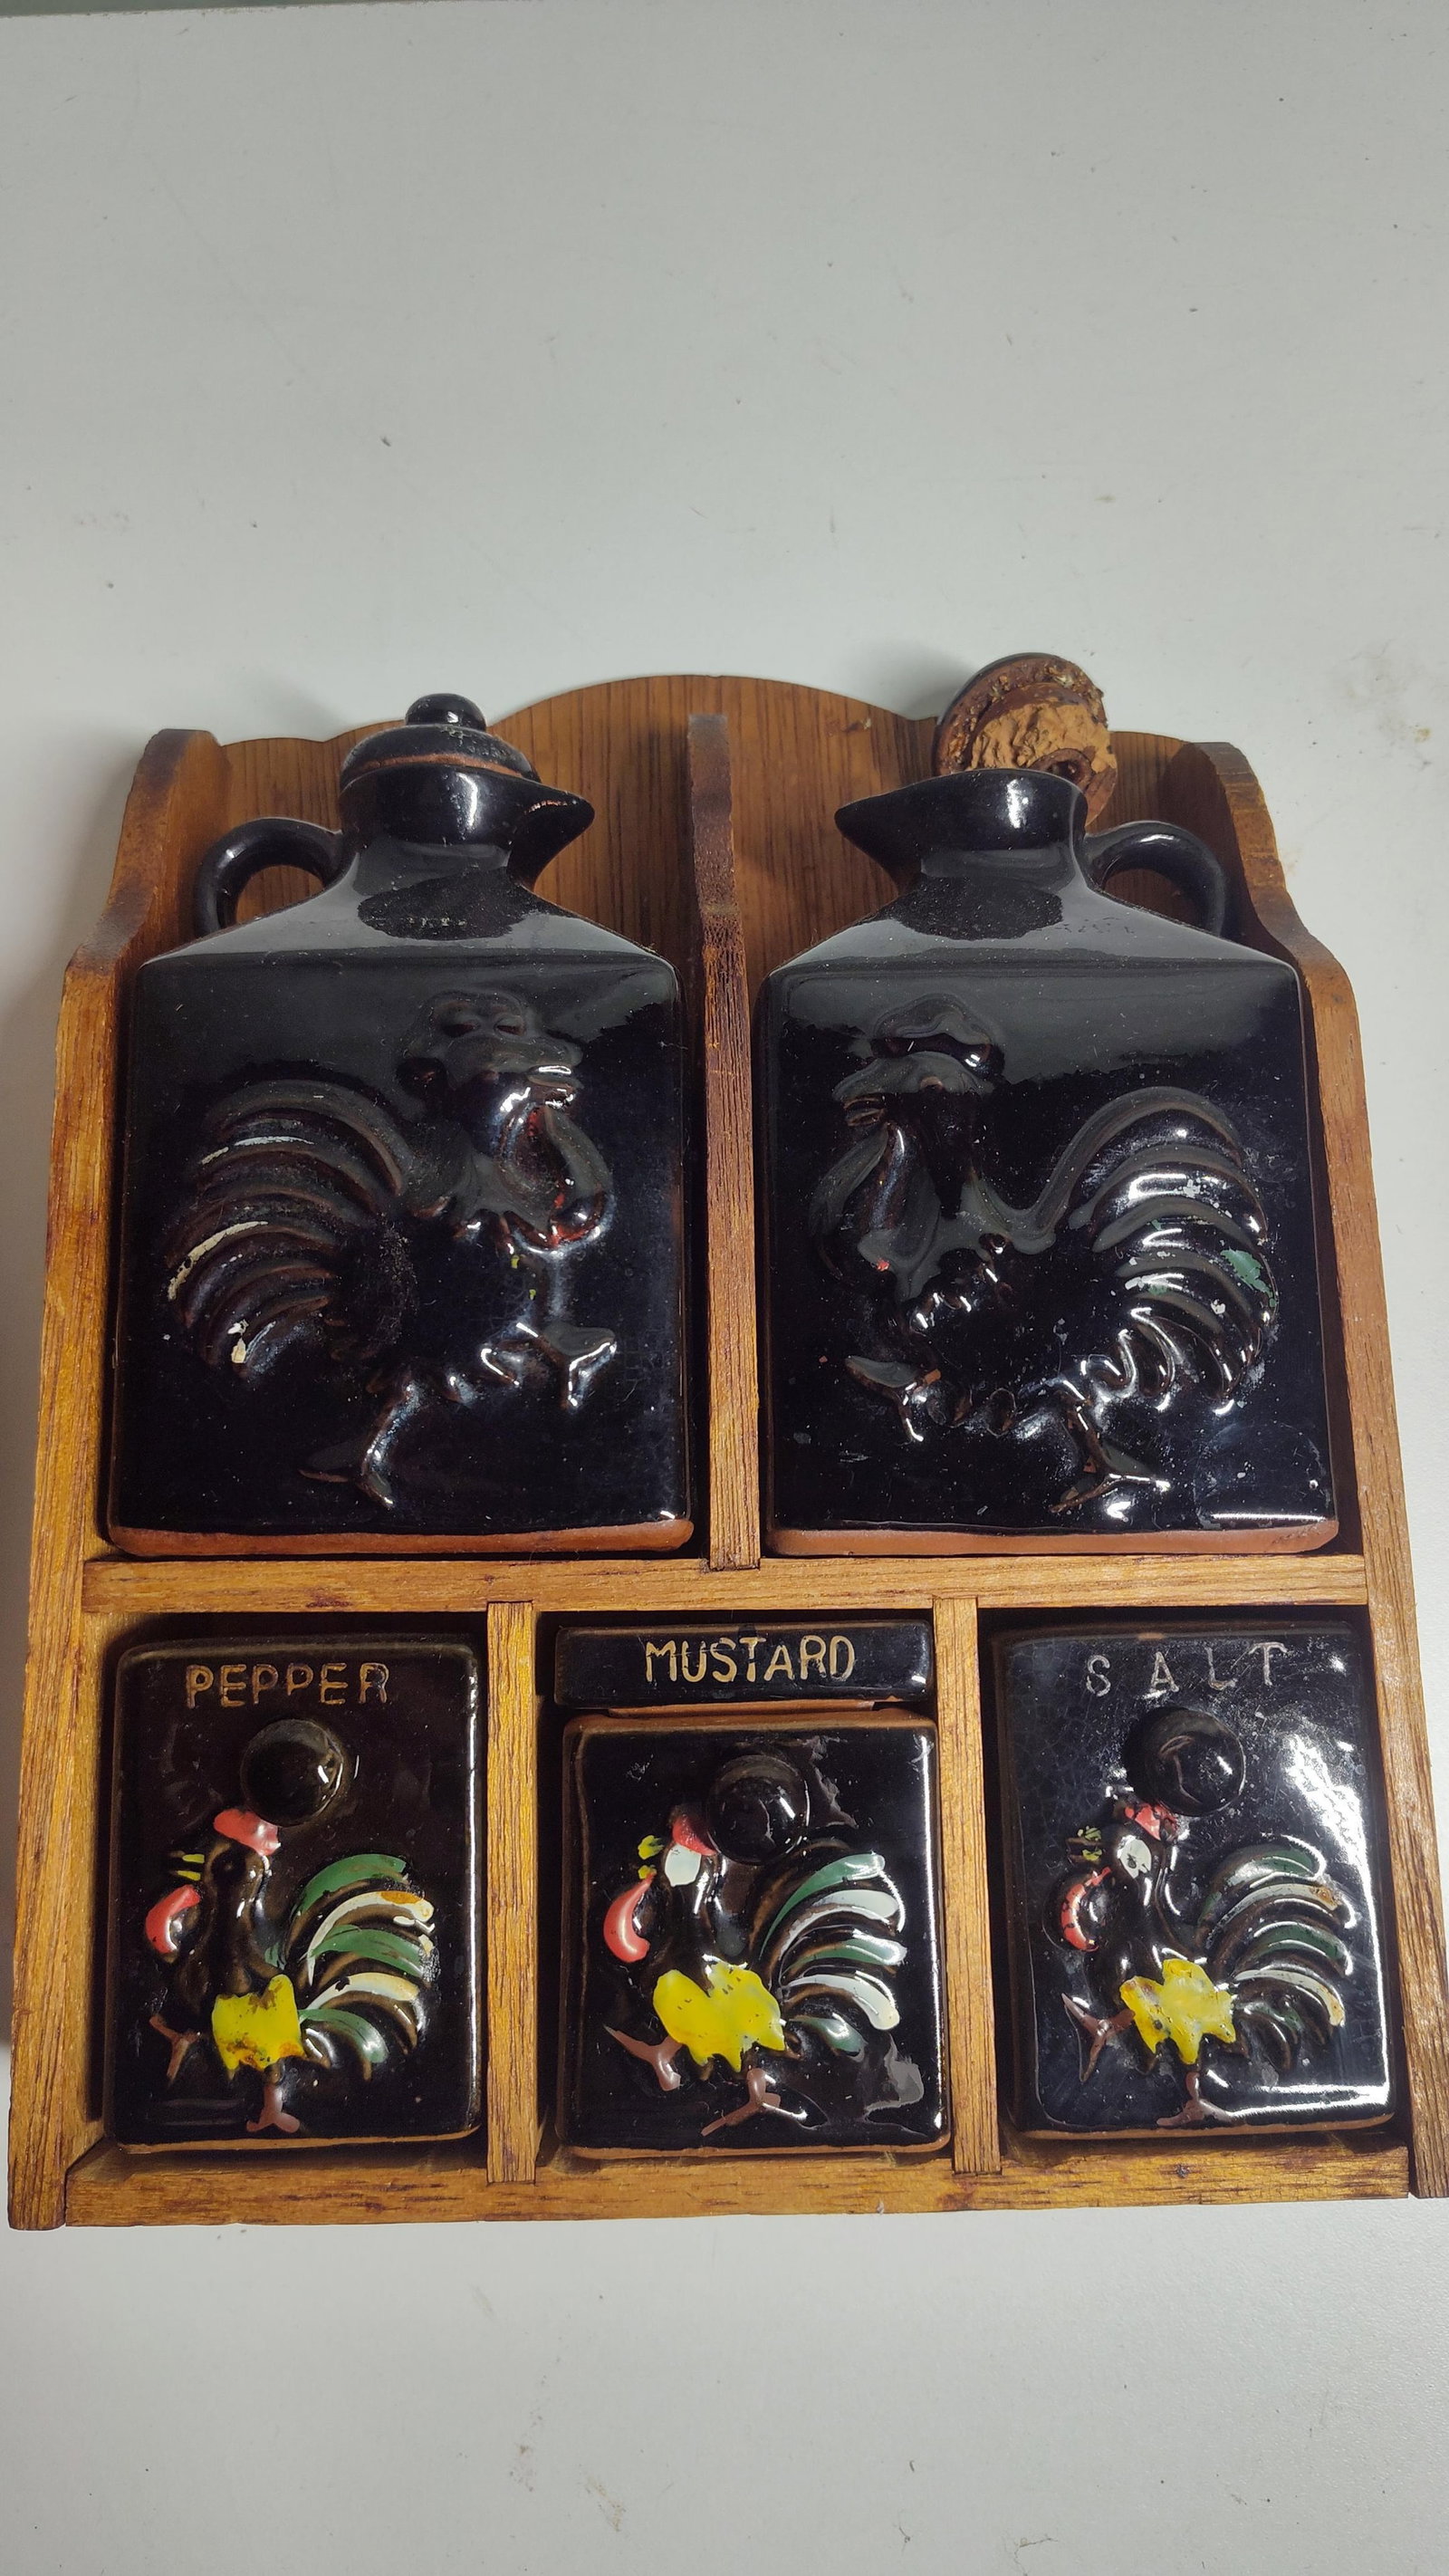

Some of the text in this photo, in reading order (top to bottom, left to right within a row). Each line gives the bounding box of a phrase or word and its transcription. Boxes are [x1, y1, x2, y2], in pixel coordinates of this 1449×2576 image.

[646, 1634, 856, 1683] MUSTARD
[1087, 1641, 1288, 1697] SALT
[186, 1662, 389, 1709] PEPPER
